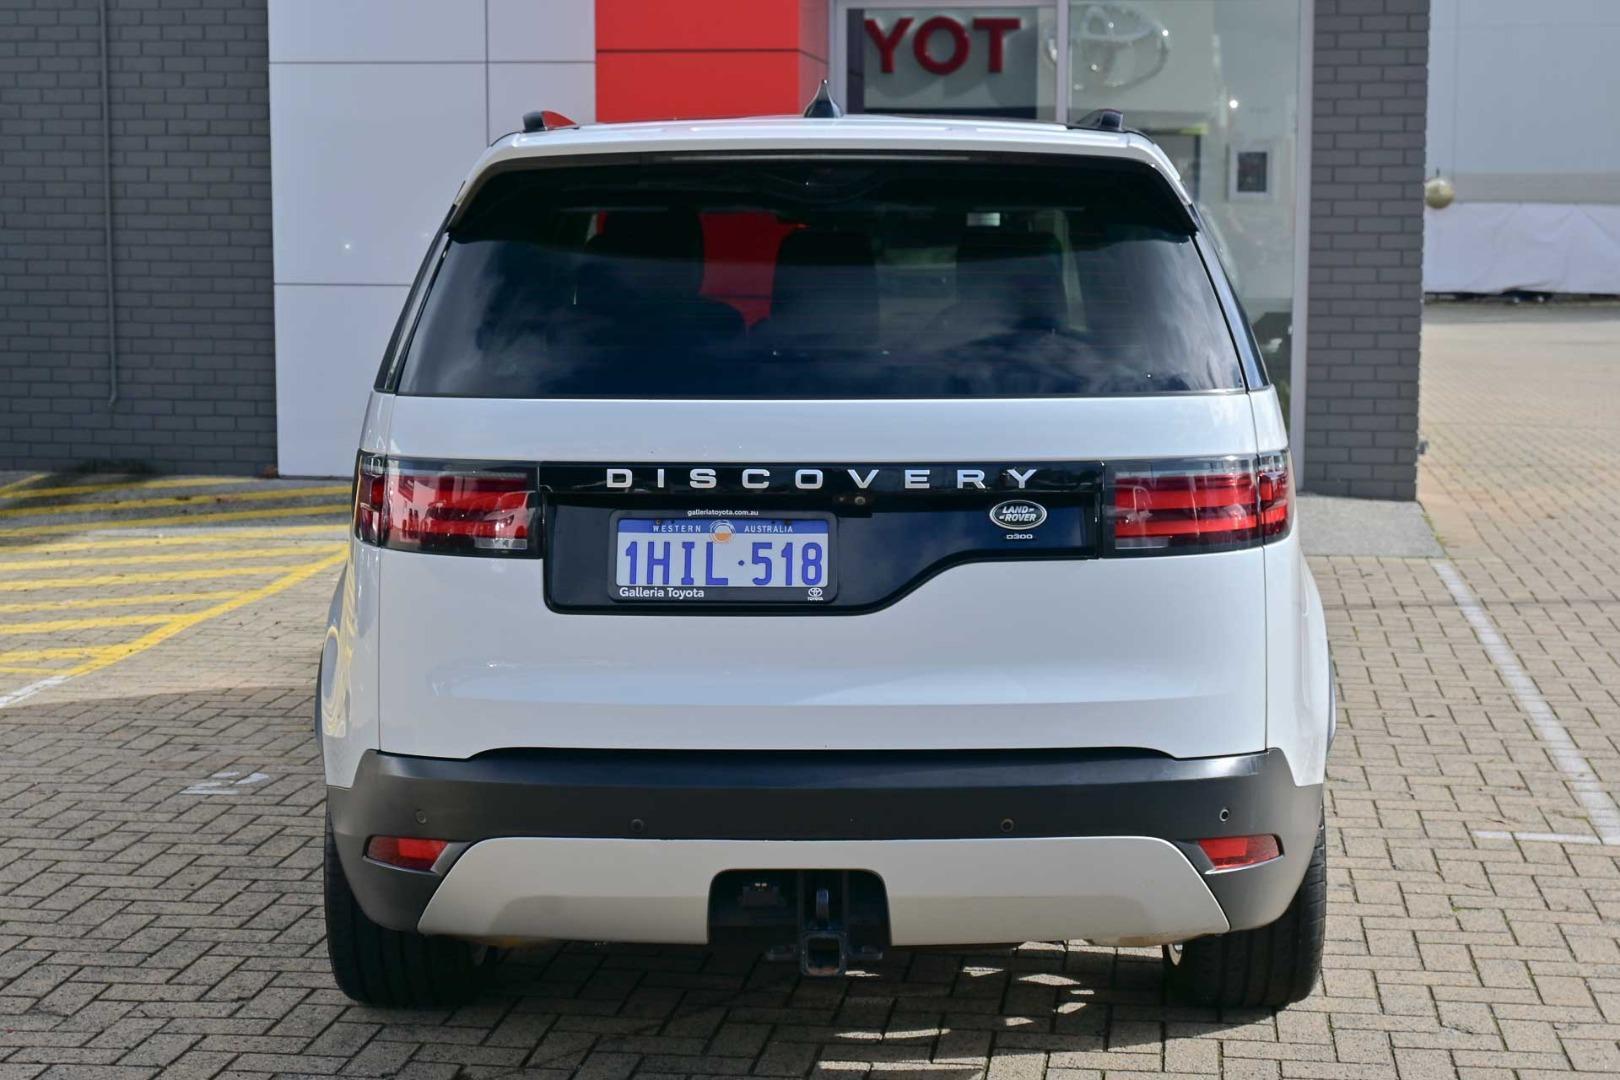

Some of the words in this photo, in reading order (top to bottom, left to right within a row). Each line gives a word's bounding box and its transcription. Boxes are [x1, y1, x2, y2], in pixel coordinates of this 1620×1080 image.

[606, 468, 1037, 489] DISCOVERY
[687, 509, 759, 517] galleriatoyota.com.au
[1002, 506, 1029, 514] LAND
[1005, 513, 1037, 522] ROVER
[653, 525, 701, 533] WESTERN
[744, 525, 793, 533] AUSTRALIA
[619, 587, 665, 597] Galleria
[666, 587, 705, 599] Toyota
